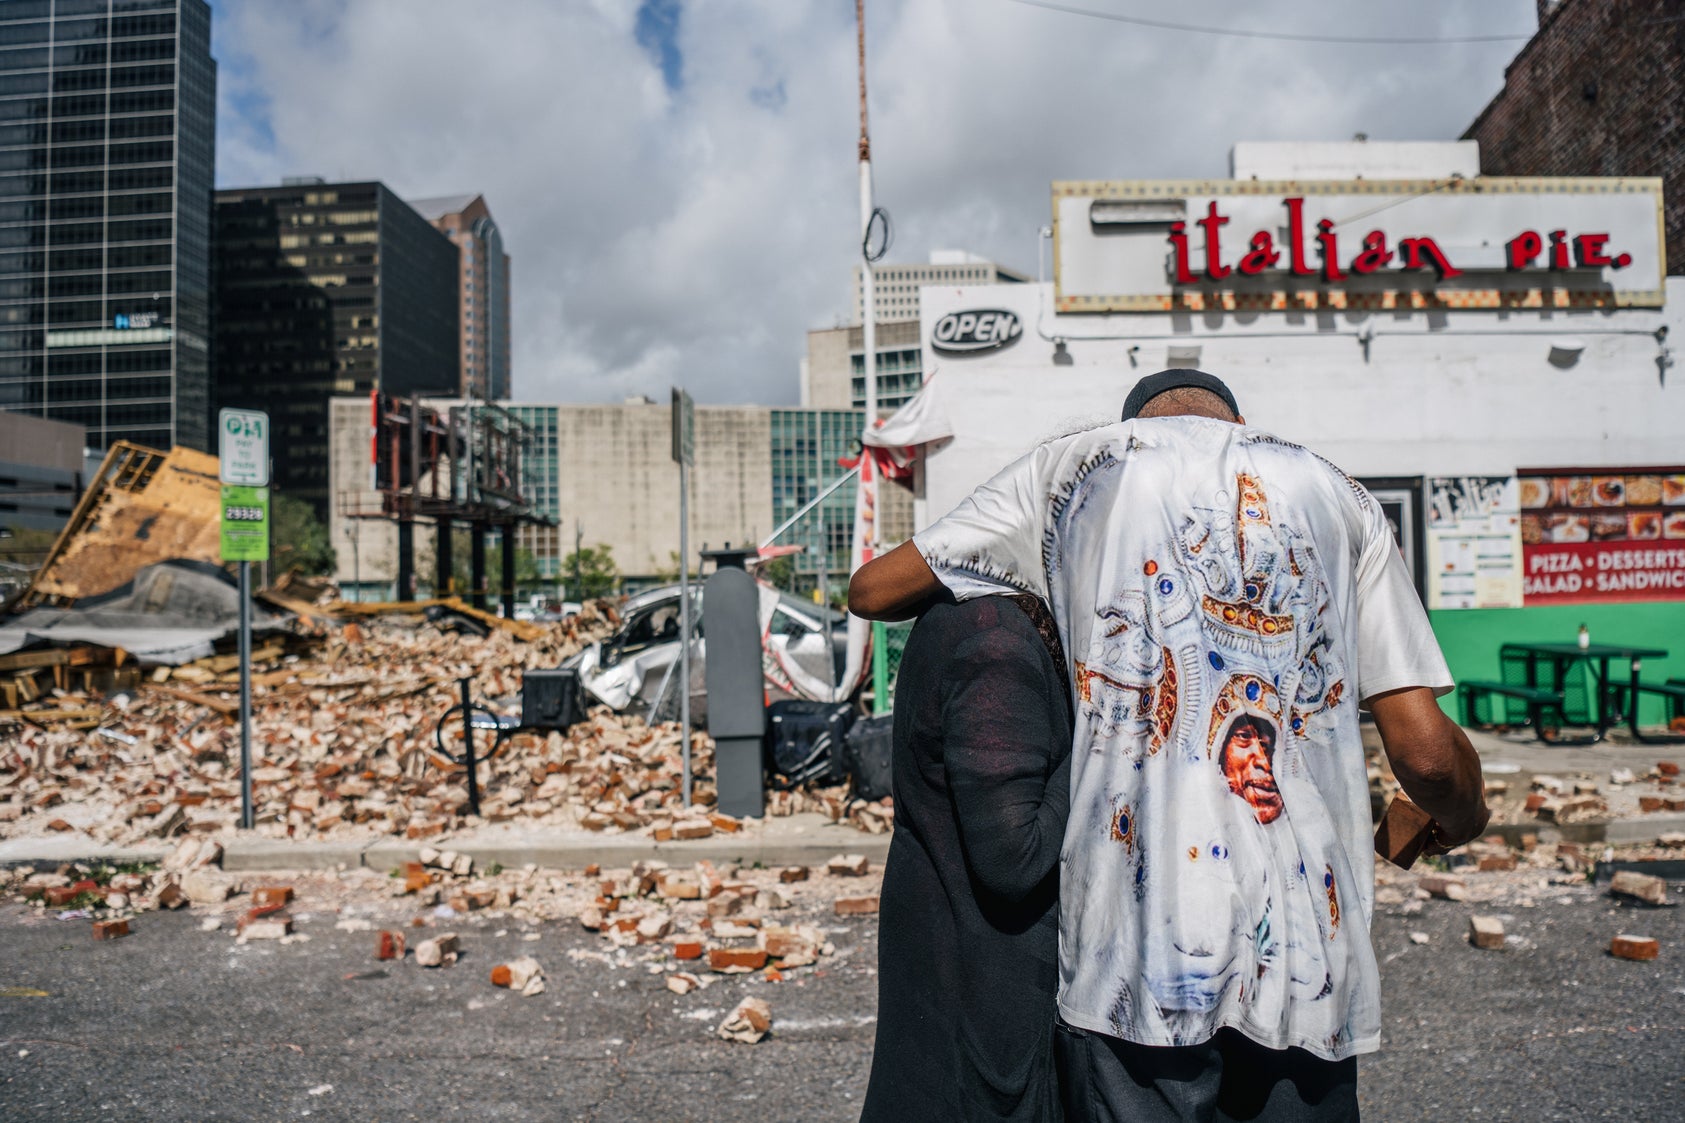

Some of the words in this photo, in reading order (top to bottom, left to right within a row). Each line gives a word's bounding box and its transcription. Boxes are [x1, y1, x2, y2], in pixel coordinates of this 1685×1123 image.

[1167, 197, 1464, 283] italian
[936, 313, 1015, 341] OPEN
[1530, 552, 1583, 574] PIZZA
[1523, 573, 1582, 595] SALAD
